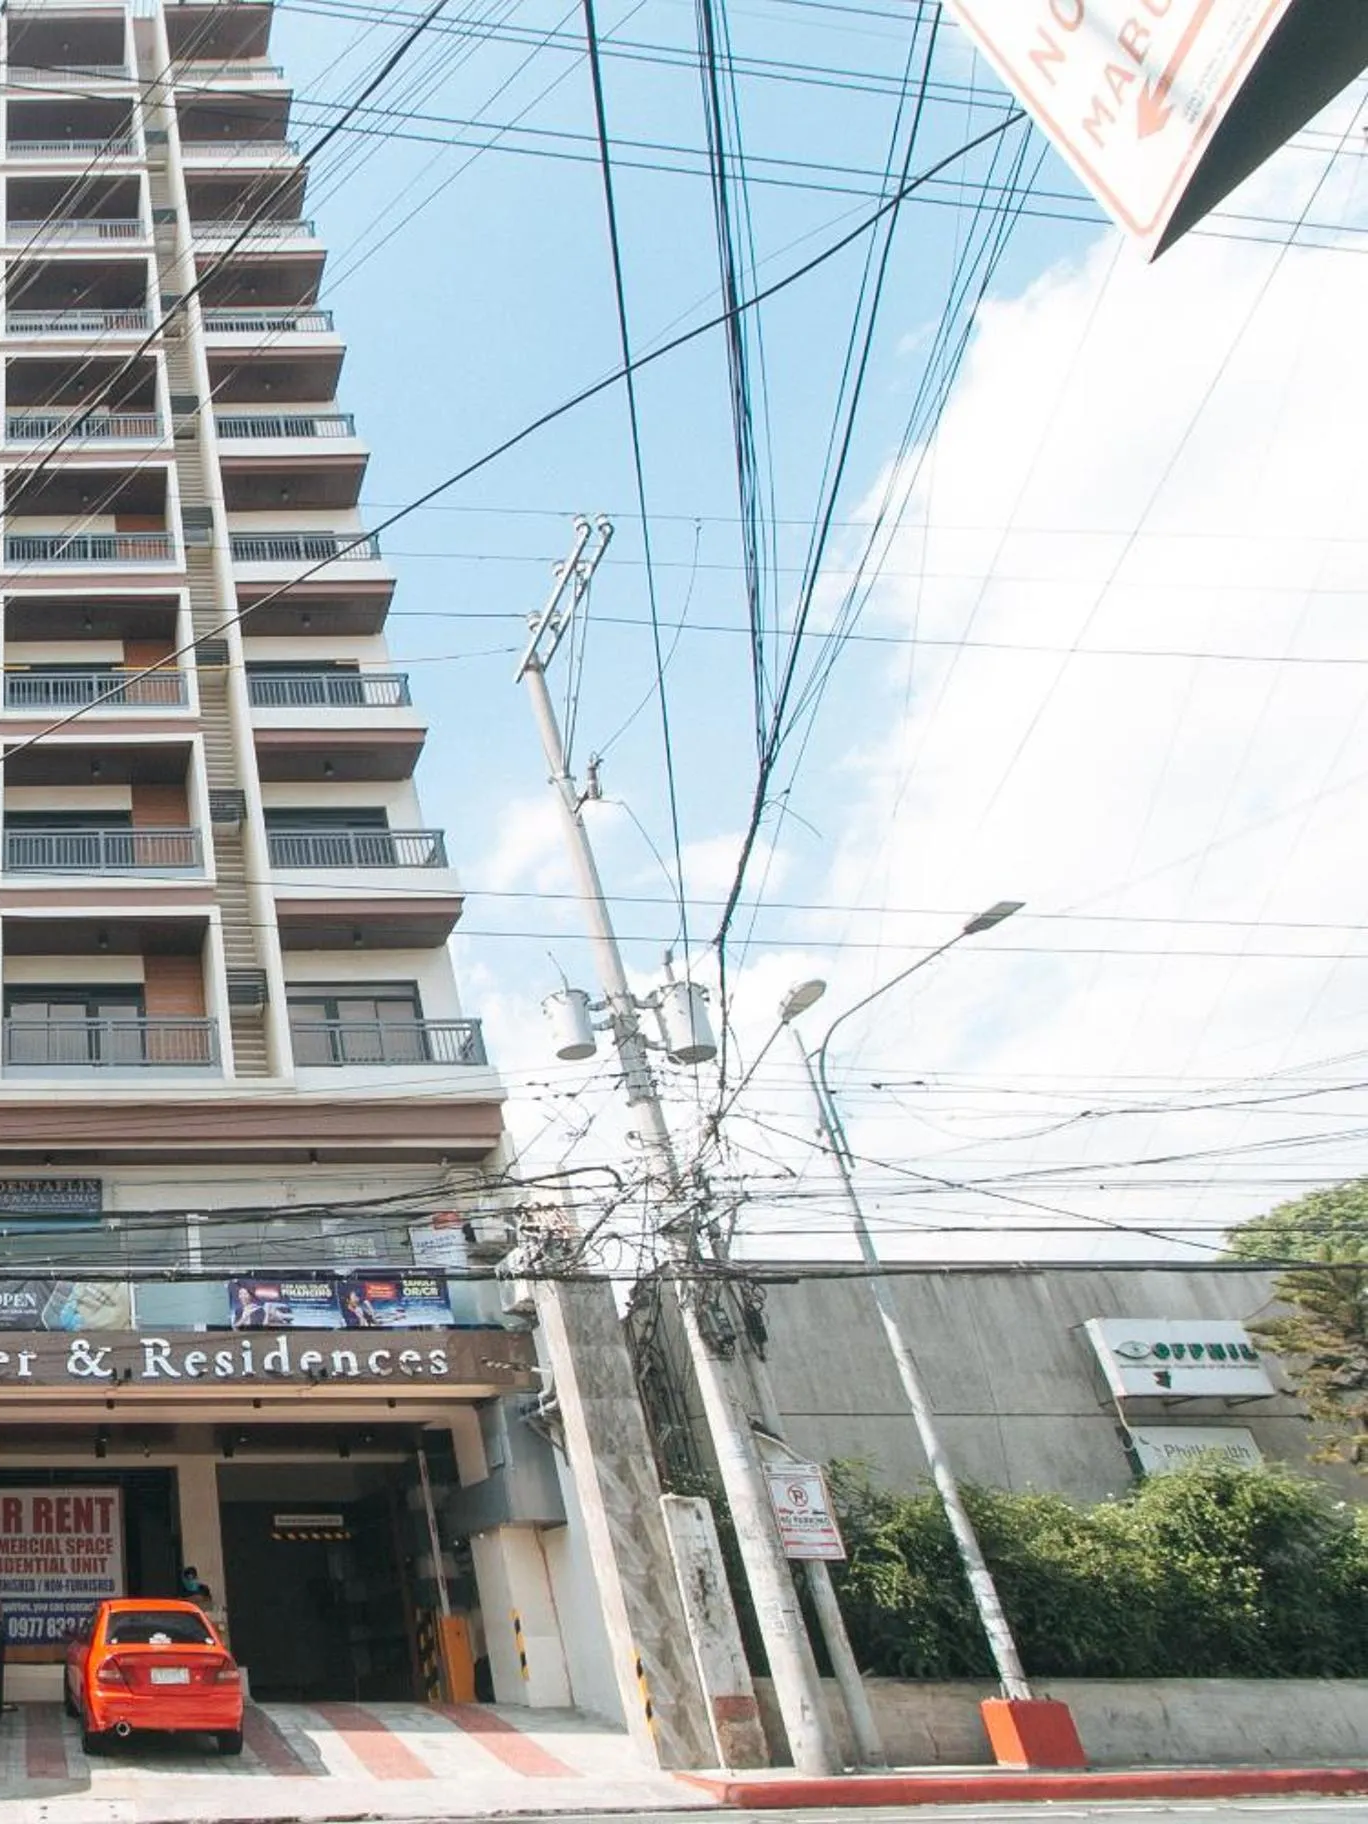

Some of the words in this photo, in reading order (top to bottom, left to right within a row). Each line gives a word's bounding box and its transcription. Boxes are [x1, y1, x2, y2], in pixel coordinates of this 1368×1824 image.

[51, 1194, 98, 1203] CLINIC
[67, 1338, 112, 1379] &
[140, 1334, 450, 1379] Residences
[1163, 1443, 1252, 1459] PhilHlth
[32, 1497, 114, 1534] RENT
[65, 1537, 114, 1555] SPACE
[71, 1557, 108, 1574] UNIT
[8, 1617, 44, 1638] 0977
